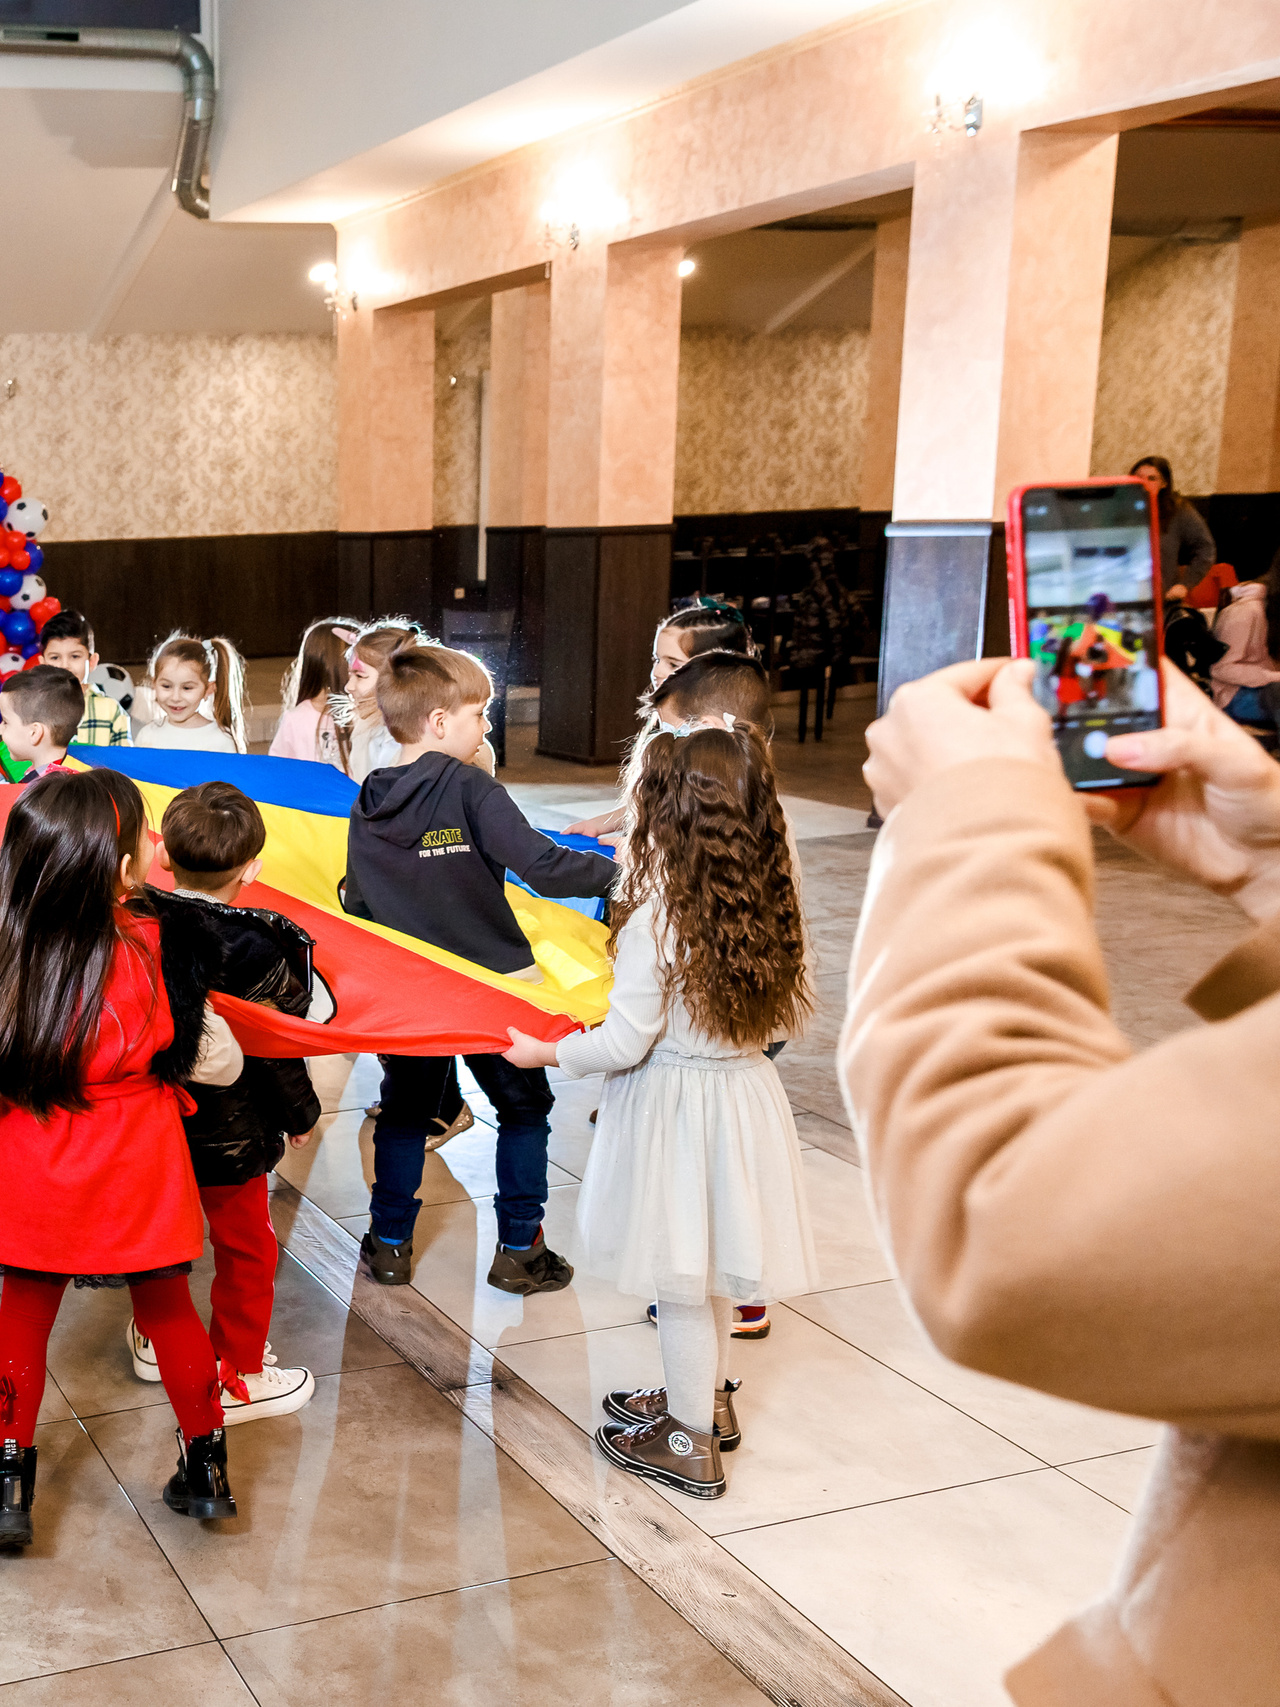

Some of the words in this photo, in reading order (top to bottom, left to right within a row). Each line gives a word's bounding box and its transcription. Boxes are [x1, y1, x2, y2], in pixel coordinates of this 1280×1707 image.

[422, 828, 464, 847] SKATE
[418, 850, 432, 858] FOR
[432, 847, 446, 856] THE
[446, 844, 471, 854] FUTURE
